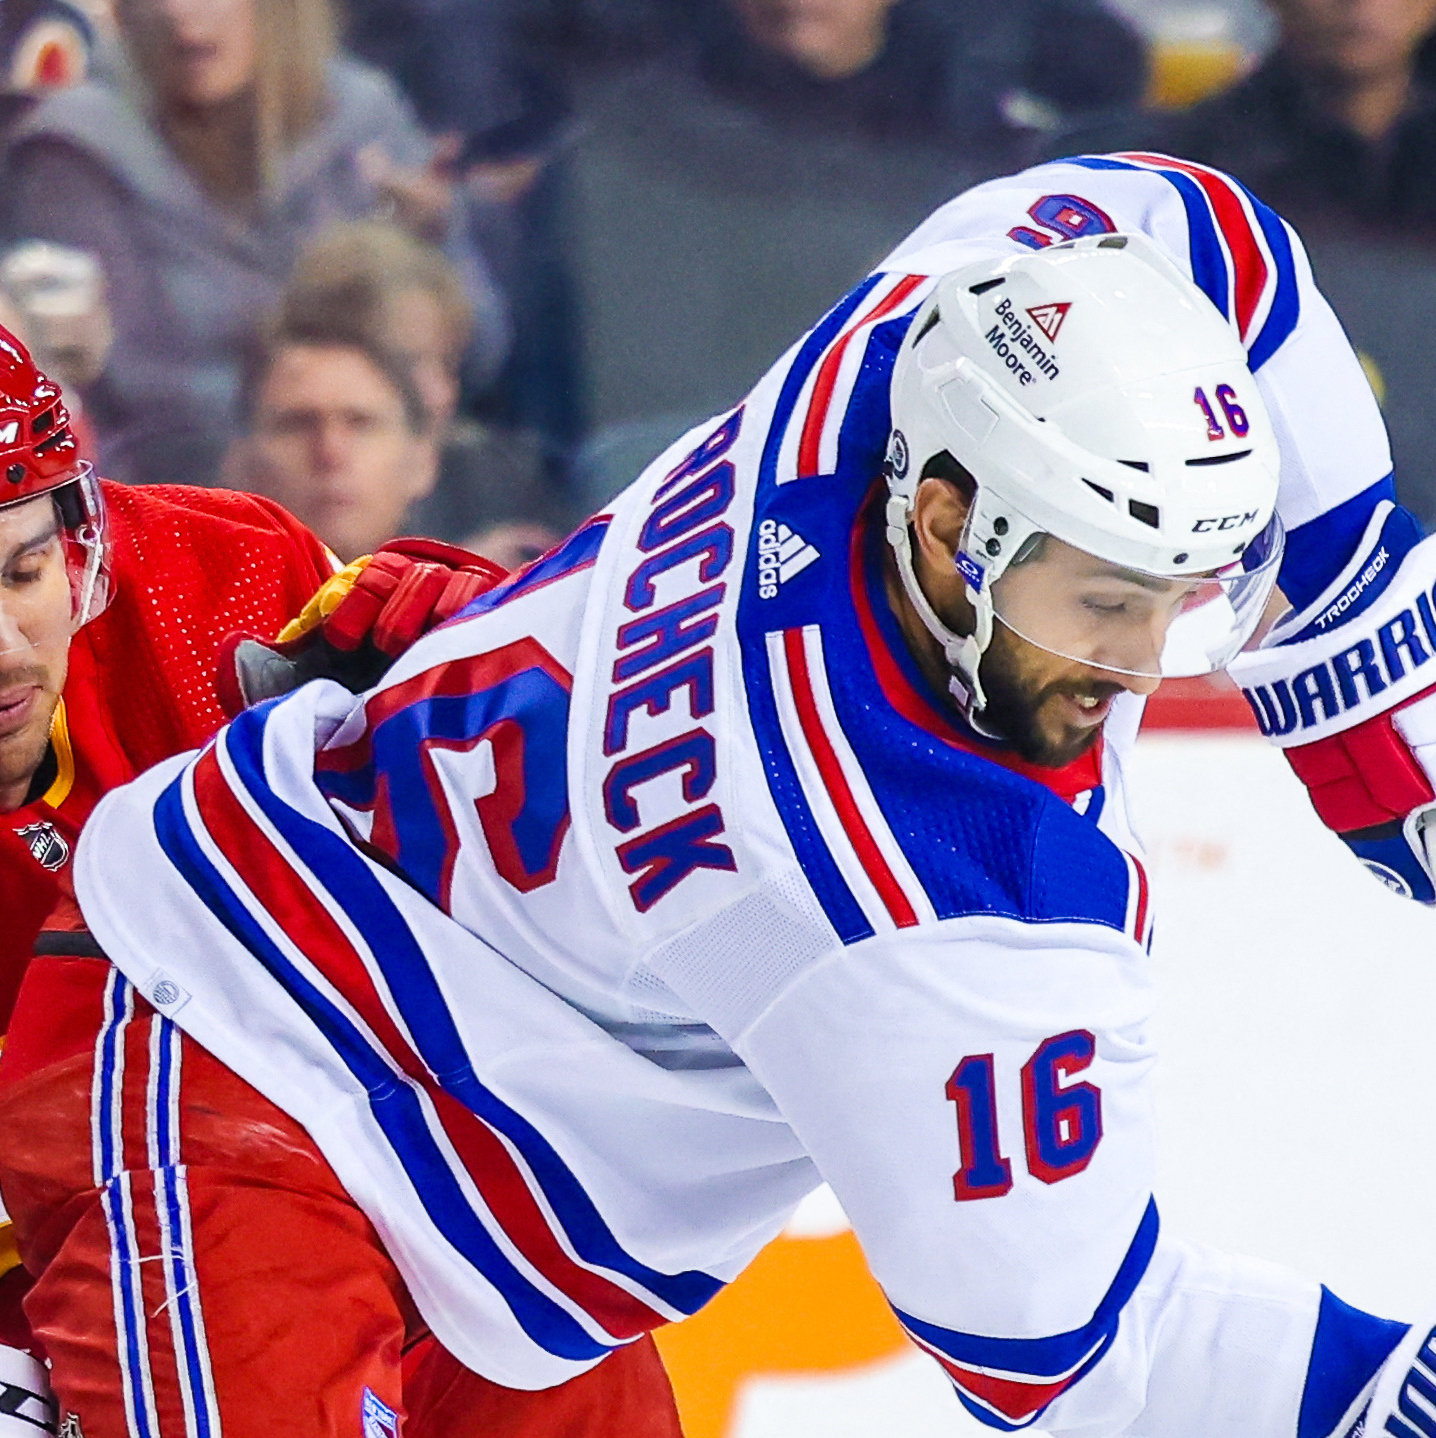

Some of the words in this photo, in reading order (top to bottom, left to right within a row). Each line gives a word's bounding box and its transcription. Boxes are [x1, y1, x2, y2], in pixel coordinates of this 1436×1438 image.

[984, 324, 1033, 386] Moore
[995, 298, 1060, 381] Benjamin
[1194, 383, 1249, 441] 16
[1191, 508, 1259, 533] CCM
[758, 519, 781, 600] adidas
[945, 1029, 1104, 1202] 16
